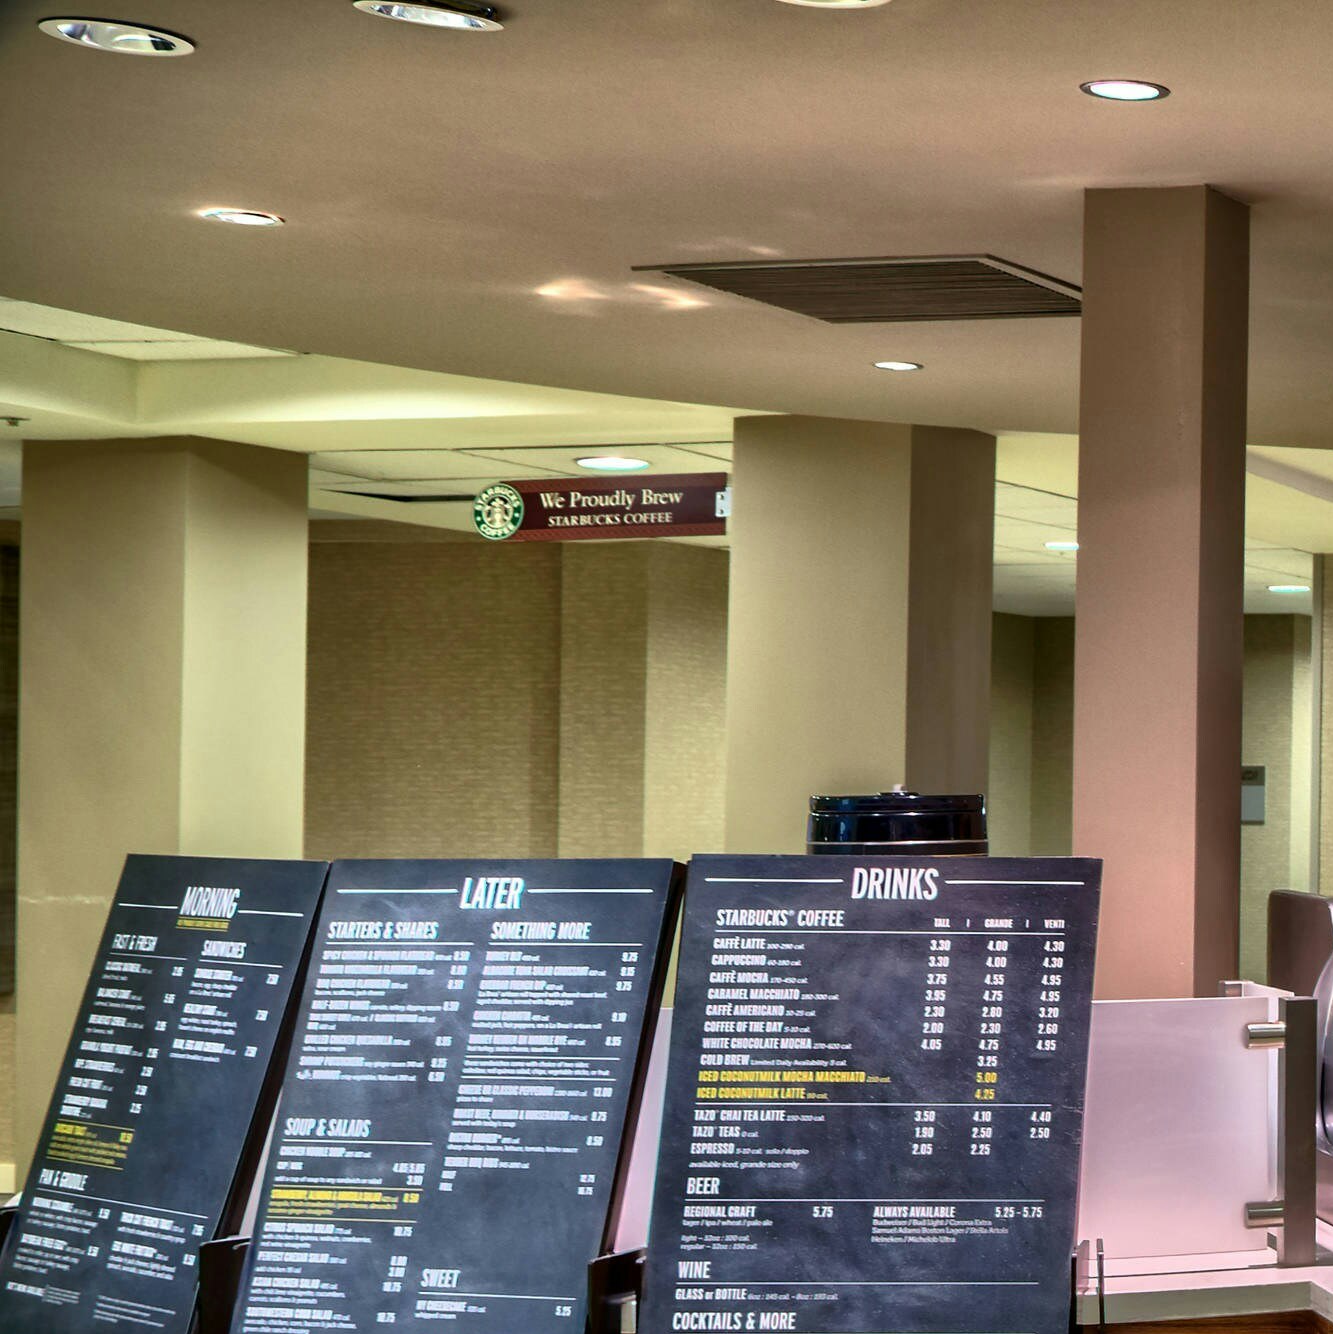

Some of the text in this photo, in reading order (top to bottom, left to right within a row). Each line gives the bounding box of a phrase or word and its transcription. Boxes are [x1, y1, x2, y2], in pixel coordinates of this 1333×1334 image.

[474, 486, 520, 510] STARBUCKS
[540, 489, 683, 510] We Proudly Brew
[548, 512, 672, 528] STARBUCKS COFFEE
[480, 525, 517, 539] COFFEE
[851, 867, 940, 902] DRINKS
[459, 877, 525, 910] LATER
[180, 886, 240, 919] MORNING
[797, 910, 845, 927] COFFEE
[1044, 920, 1065, 928] VENTI
[328, 921, 440, 940] STARTERS & SHARES
[490, 922, 592, 940] SOMETHING MORE
[713, 936, 1065, 952] CAFFÈ LATTE 3.30 4.00 4.30
[712, 955, 766, 966] CAPPUCCINO
[928, 956, 950, 968] 3.30
[1042, 957, 1064, 968] 4.30
[710, 970, 1062, 986] CAFFÈ MOCHA 3.75 4.55 4.95
[708, 988, 1060, 1002] CARAMEL MACCHIATO 3.95 4.75 4.95
[706, 1002, 733, 1016] CAFFÈ
[734, 1006, 784, 1016] AMERICANO
[924, 1006, 946, 1018] 2.30
[1039, 1007, 1060, 1018] 3.20
[704, 1022, 736, 1032] COFFEE
[736, 1022, 748, 1033] OF
[748, 1022, 763, 1033] THE
[763, 1022, 784, 1033] DAY
[980, 1023, 1002, 1034] 2.30
[702, 1038, 730, 1049] WHITE
[730, 1038, 780, 1050] CHOCOLATE
[780, 1038, 812, 1050] MOCHA
[978, 1040, 999, 1051] 4.75
[1036, 1040, 1056, 1052] 4.95
[700, 1054, 998, 1067] COLD BREW 3.25
[698, 1070, 718, 1082] ICED
[782, 1072, 814, 1082] MOCHA
[696, 1087, 716, 1098] ICED
[780, 1088, 806, 1099] LATTE
[974, 1088, 996, 1100] 4.25
[720, 1110, 1052, 1122] CHAI TEA LATTE 3.50 4.10 4.40
[284, 1118, 372, 1139] SOUP & SALADS
[718, 1126, 1050, 1139] TEAS 1.90 2.50 2.50
[690, 1143, 990, 1156] ESPRESSO 2.05 2.25
[686, 1178, 720, 1194] BEER
[684, 1206, 1043, 1218] REGIONAL CRAFT 5.75 ALWAYS AVAILABLE 5.25 5.75
[420, 1268, 461, 1288] SWEET
[678, 1262, 712, 1279] WINE
[675, 1288, 748, 1300] GLASS or BOTTLE
[672, 1312, 796, 1330] COCKTAILS & MORE
